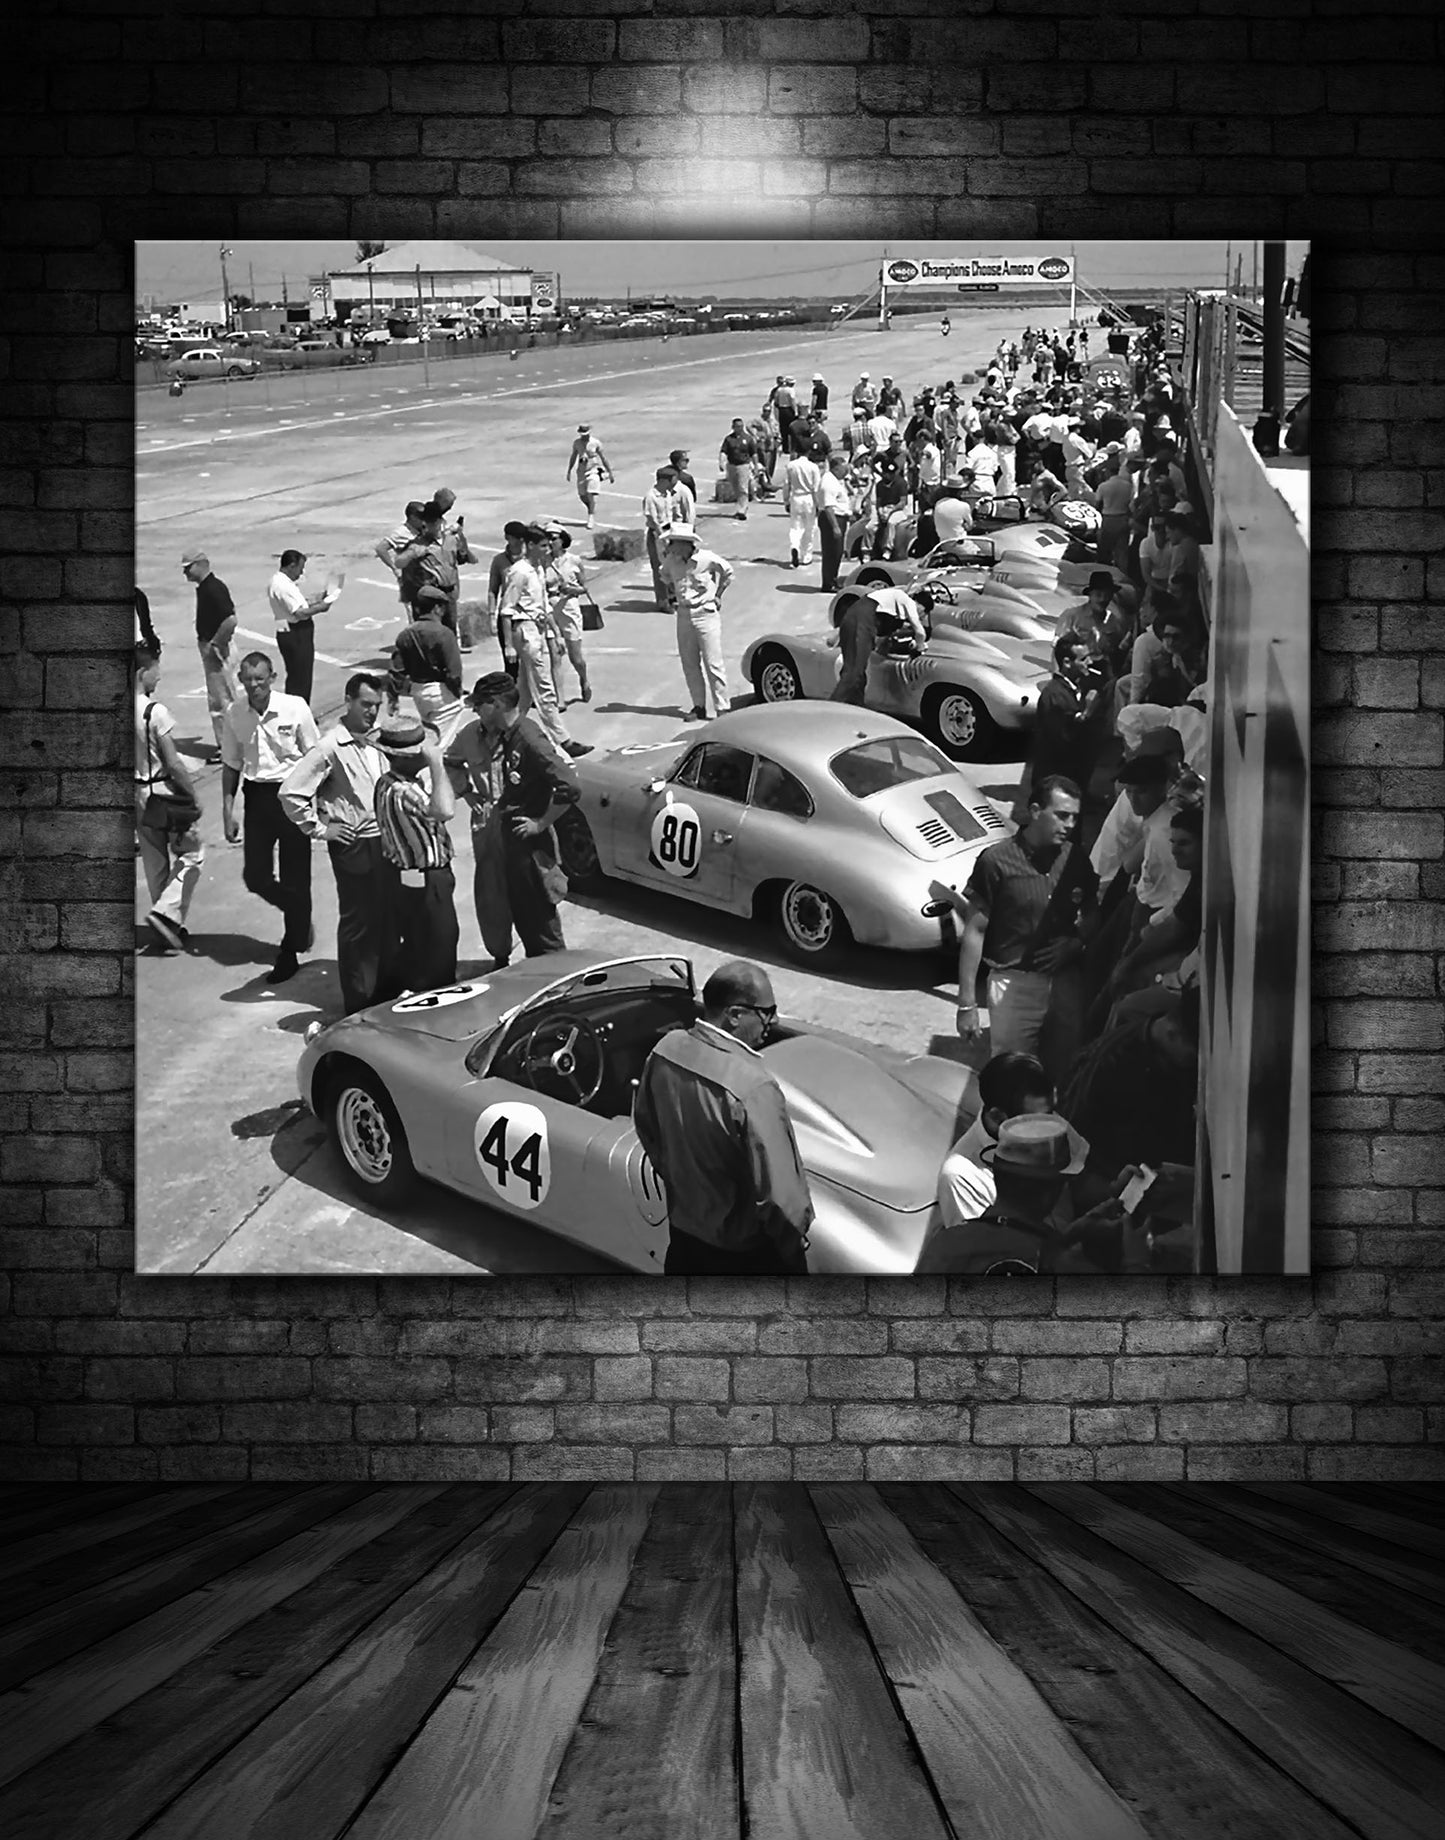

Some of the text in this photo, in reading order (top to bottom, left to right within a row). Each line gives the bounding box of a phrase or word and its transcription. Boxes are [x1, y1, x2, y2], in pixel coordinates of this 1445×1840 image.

[922, 260, 1034, 280] Champions Choose Amoco
[1040, 265, 1068, 273] AMOCO
[660, 815, 698, 868] 80
[479, 1115, 542, 1202] 44
